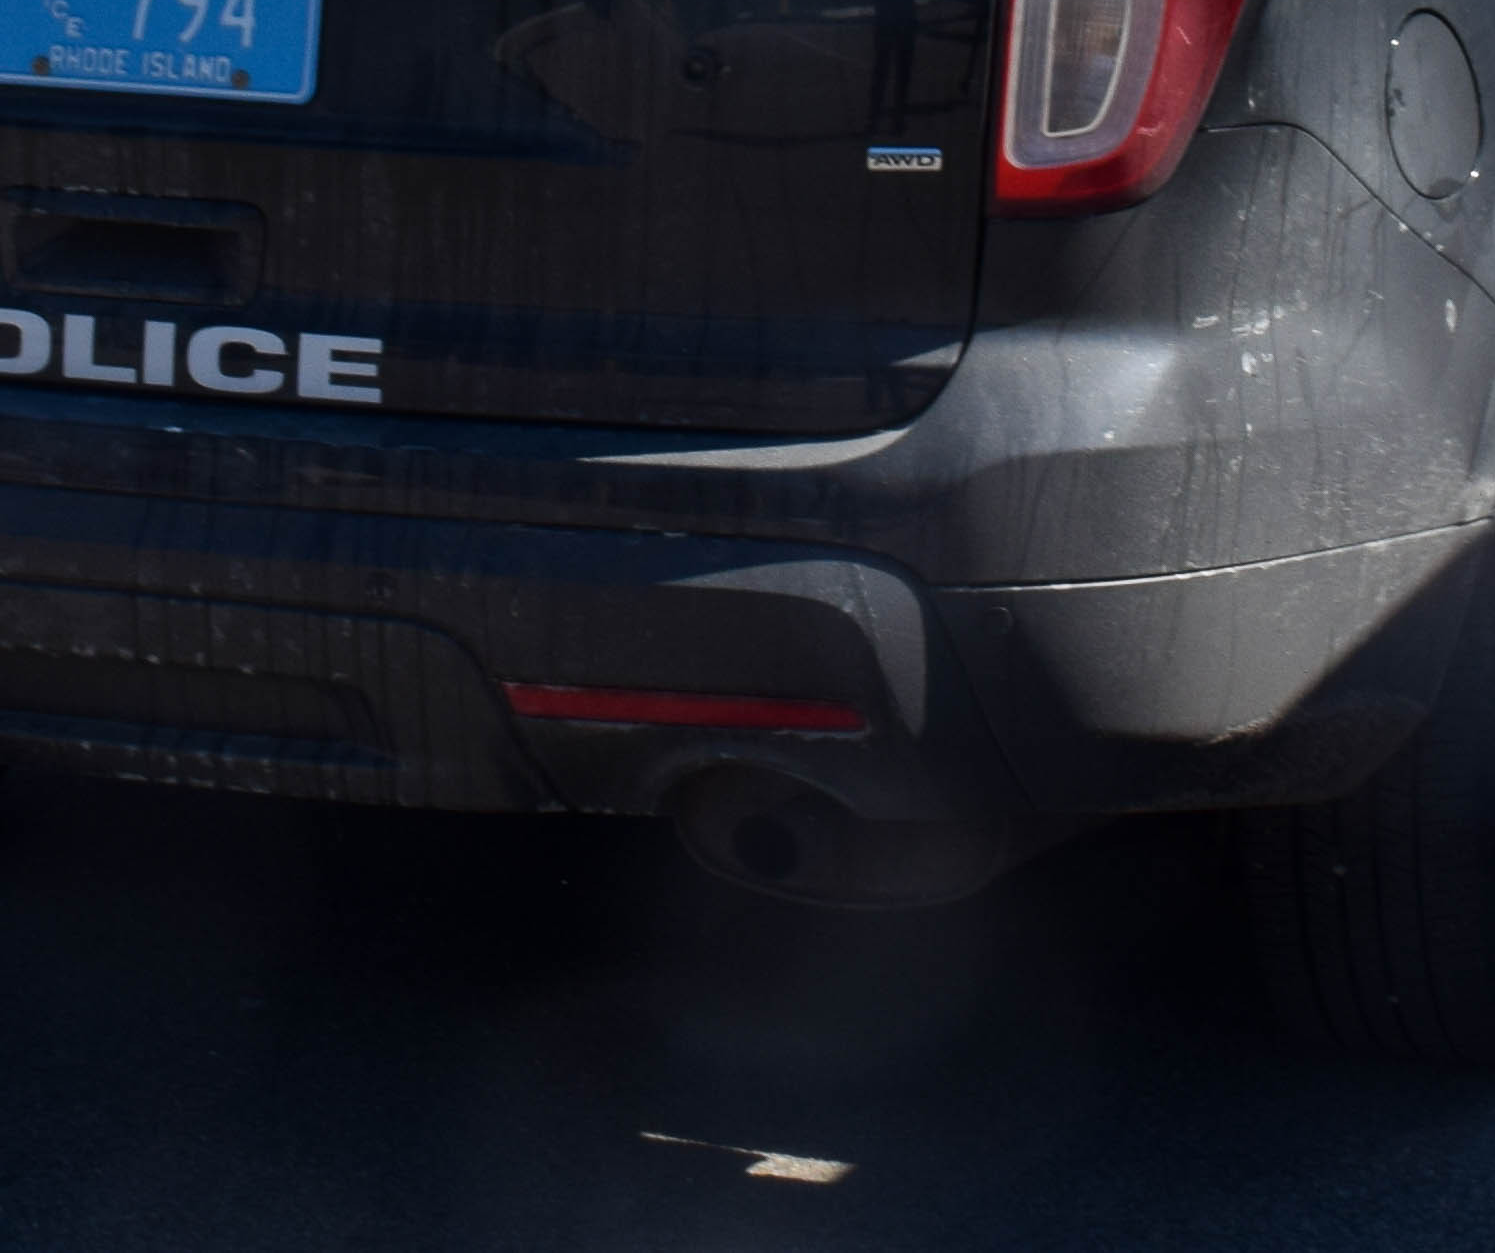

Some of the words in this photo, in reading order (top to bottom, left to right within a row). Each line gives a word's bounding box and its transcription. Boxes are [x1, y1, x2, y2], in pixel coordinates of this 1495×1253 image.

[47, 44, 130, 76] RHODE
[140, 50, 232, 84] ISLAND
[873, 154, 935, 167] AWD
